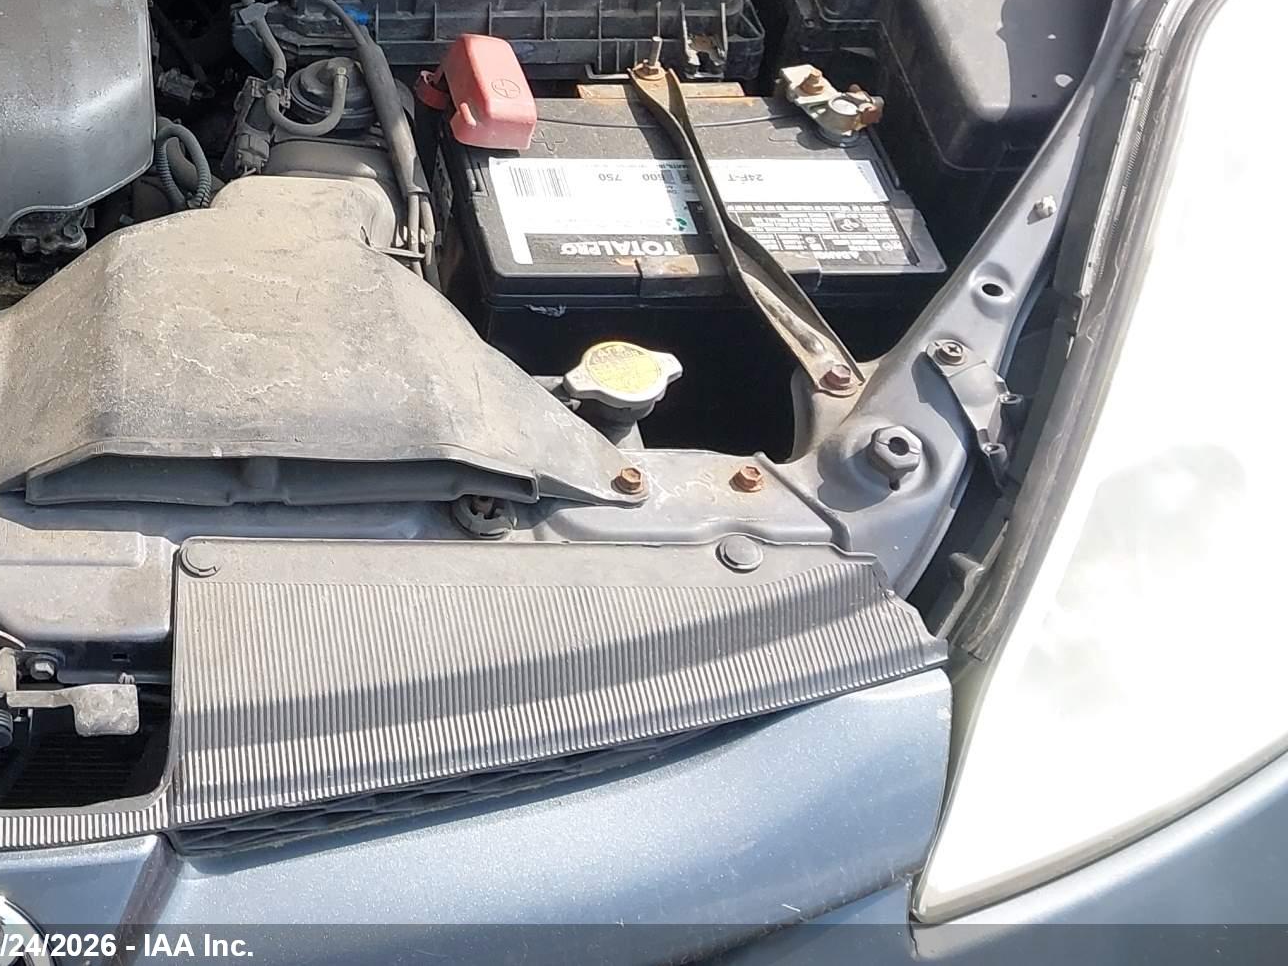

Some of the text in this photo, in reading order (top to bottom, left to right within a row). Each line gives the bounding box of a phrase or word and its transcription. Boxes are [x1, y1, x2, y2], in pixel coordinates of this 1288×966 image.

[598, 172, 623, 182] 750
[728, 173, 764, 183] 24F-T
[560, 240, 680, 255] TOTALPRO
